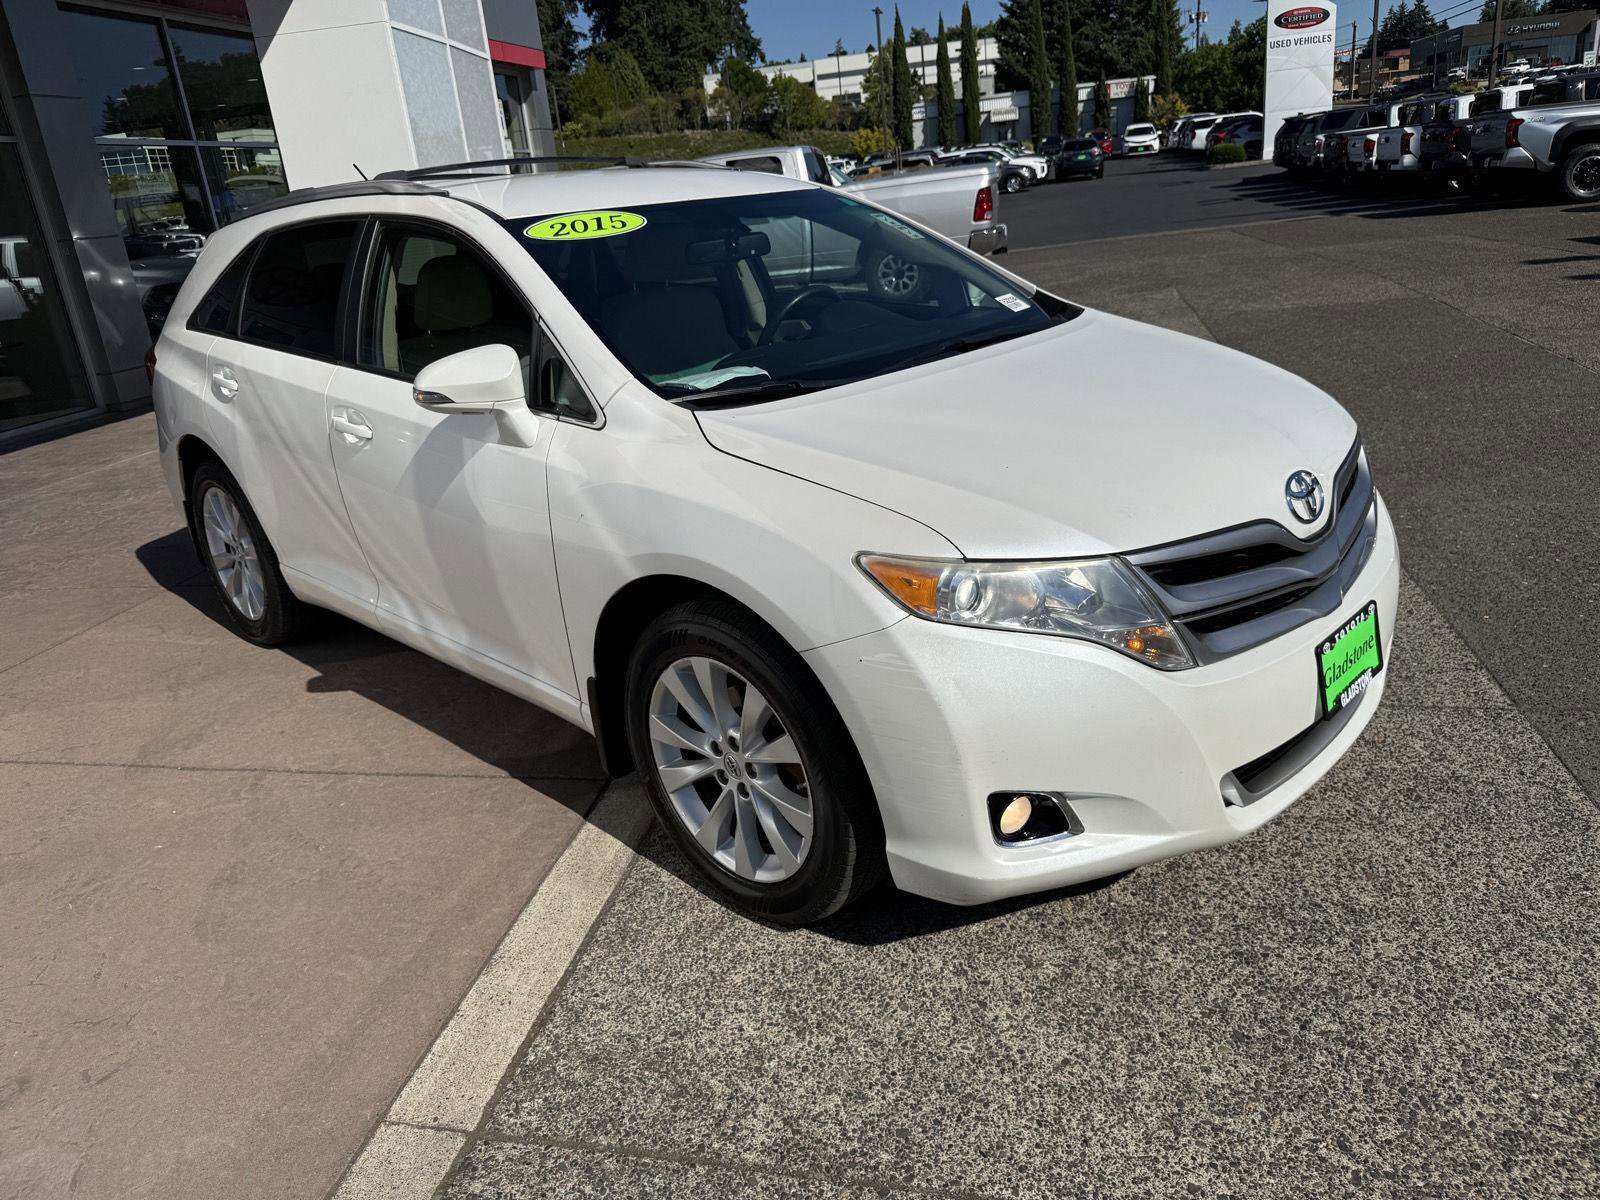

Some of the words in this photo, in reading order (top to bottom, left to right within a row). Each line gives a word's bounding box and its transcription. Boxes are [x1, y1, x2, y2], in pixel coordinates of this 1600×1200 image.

[1281, 12, 1323, 23] CERTIFIED
[1523, 21, 1560, 31] HYUNDAI
[1270, 39, 1291, 49] USED
[1294, 34, 1332, 46] VEHICLES
[550, 214, 627, 237] 2015
[1334, 612, 1365, 643] TOYOTA
[1324, 634, 1374, 689] Gladstone
[1340, 667, 1373, 708] GLADSTONE
